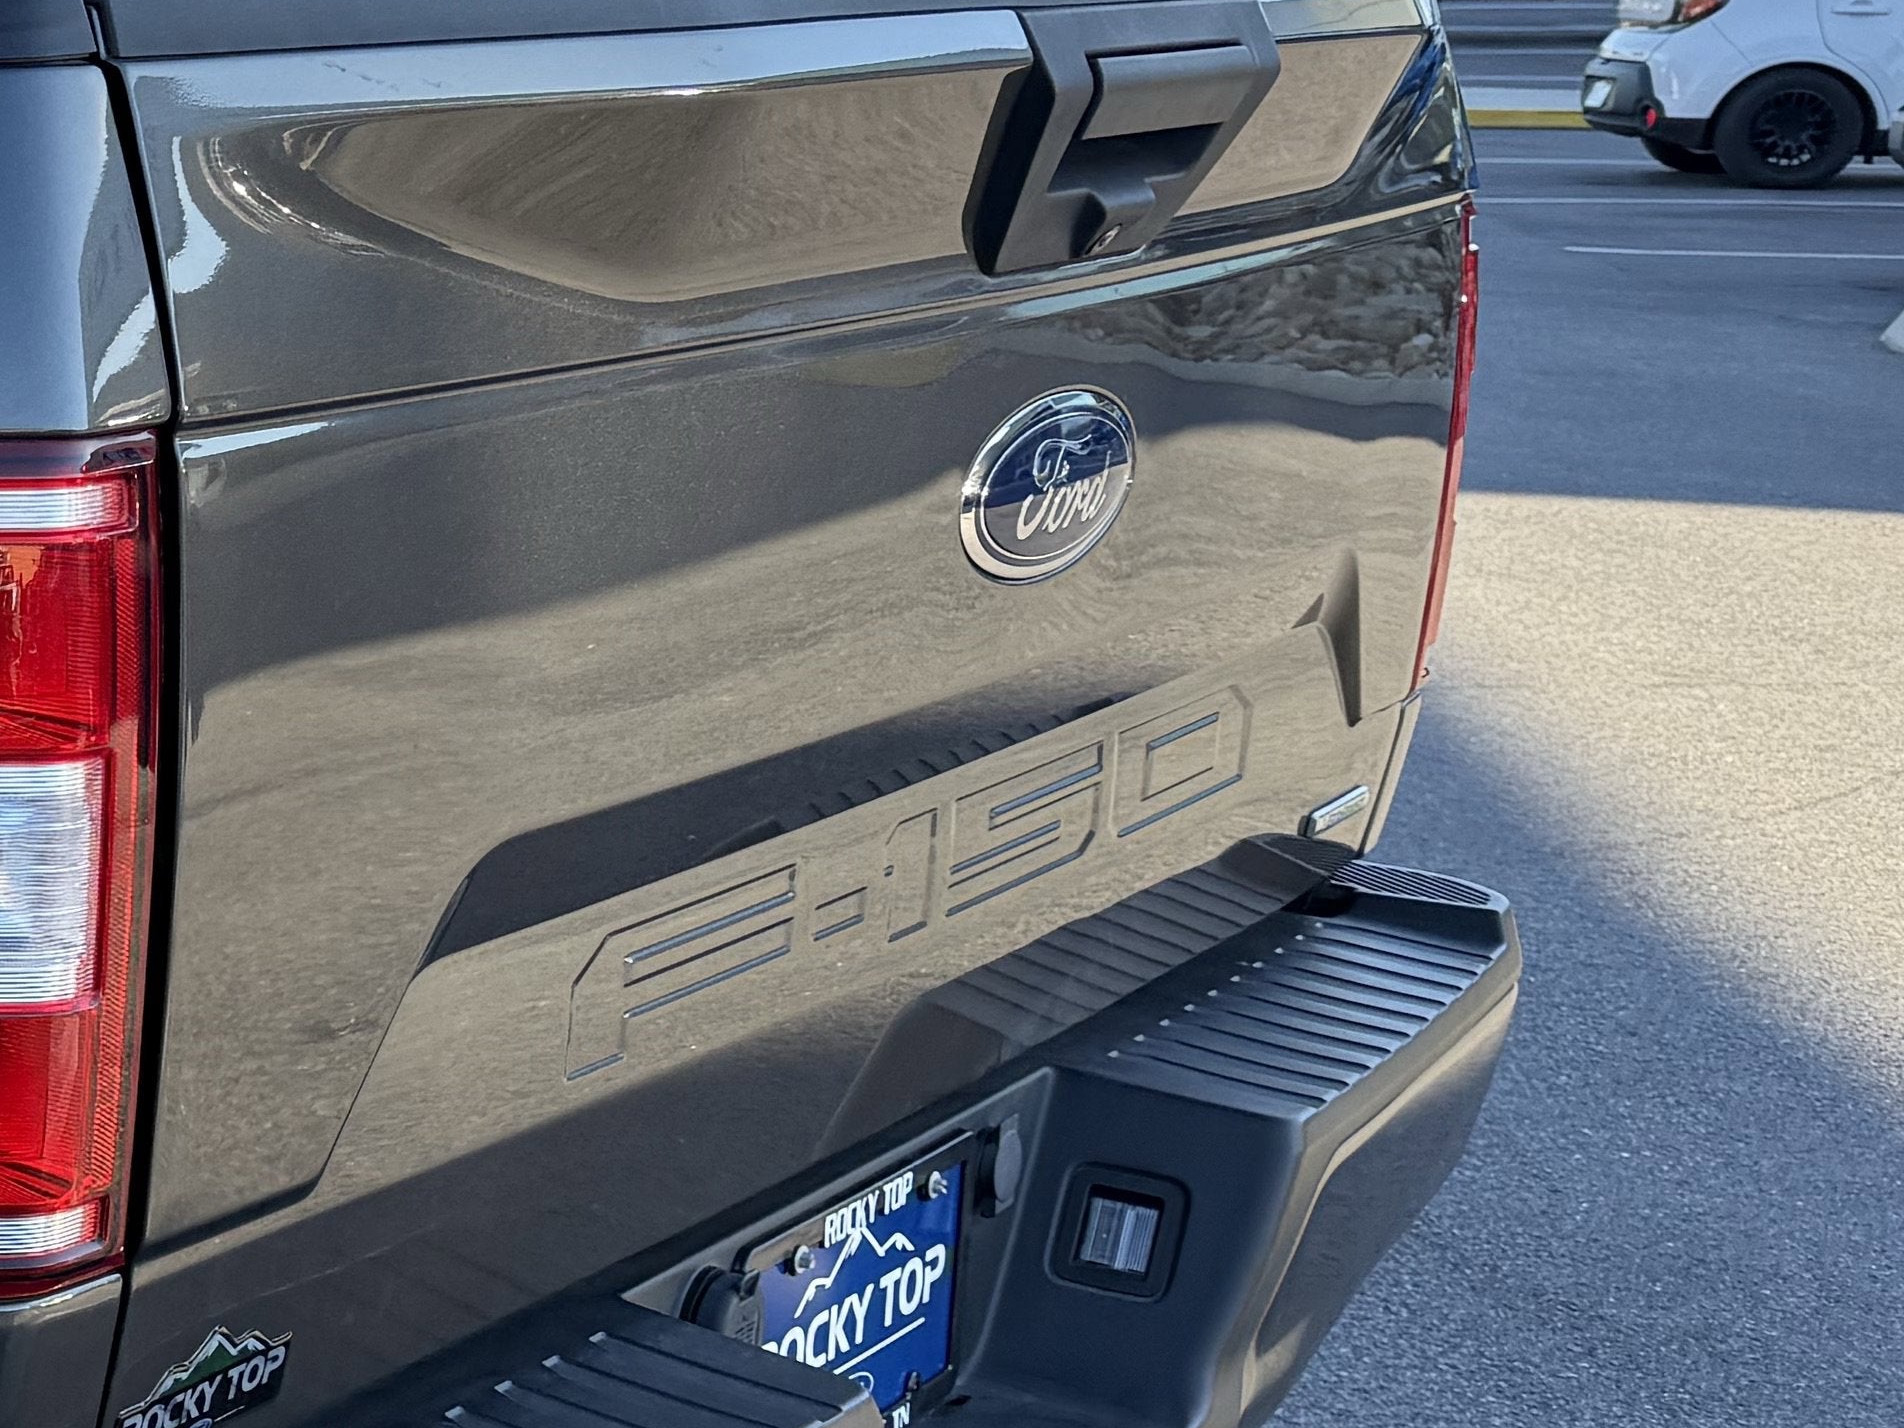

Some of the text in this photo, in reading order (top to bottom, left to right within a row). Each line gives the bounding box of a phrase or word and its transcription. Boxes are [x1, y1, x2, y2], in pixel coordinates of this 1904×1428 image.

[1016, 434, 1113, 541] Ford
[565, 685, 1253, 1081] F-150
[824, 1171, 914, 1248] ROCKY TOP
[880, 1243, 947, 1328] TOP
[227, 1345, 287, 1400] TOP
